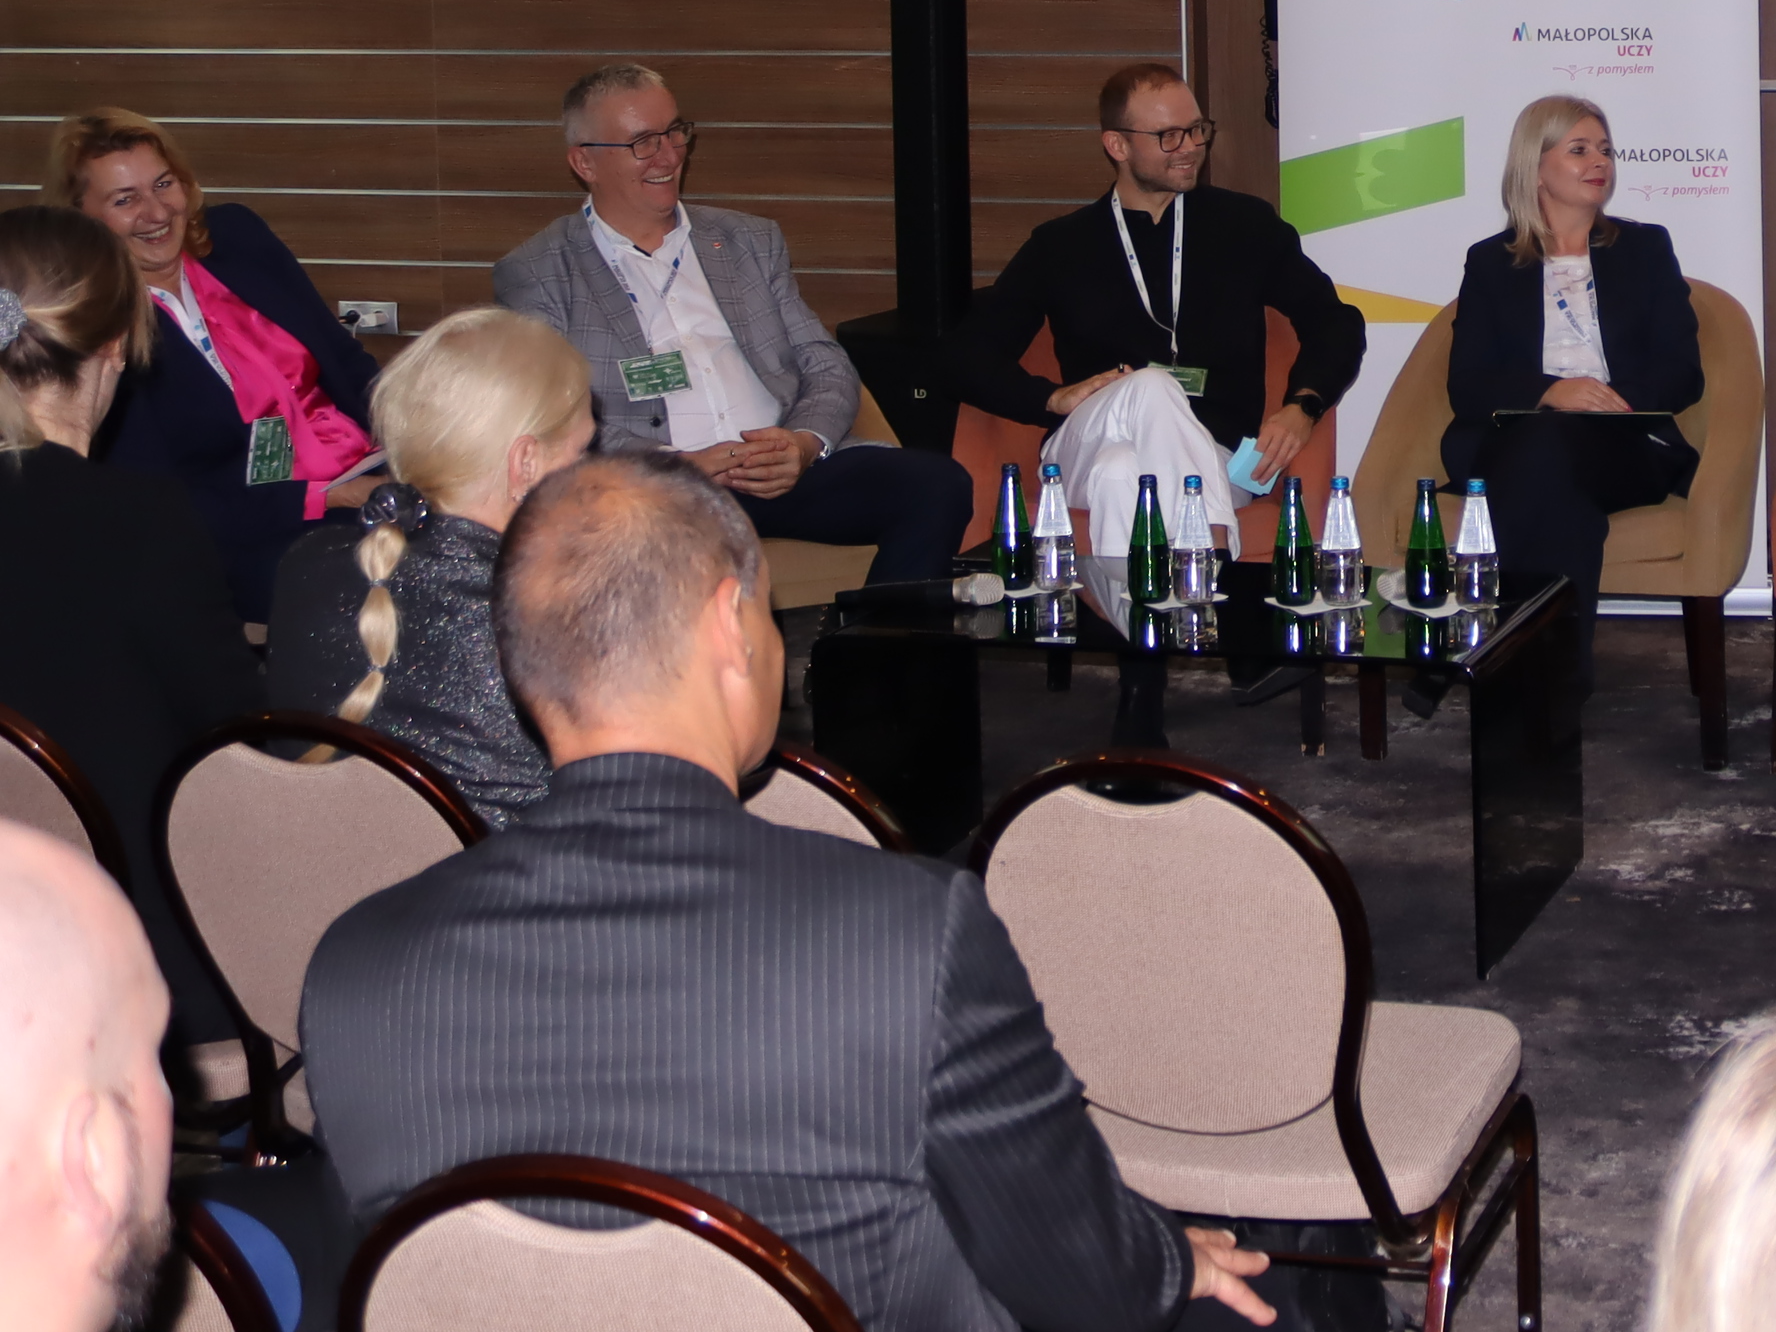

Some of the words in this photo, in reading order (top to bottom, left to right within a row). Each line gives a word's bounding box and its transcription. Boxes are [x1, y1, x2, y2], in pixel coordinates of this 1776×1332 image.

[1537, 27, 1653, 42] MAŁOPOLSKA
[1617, 45, 1653, 57] UCZY
[1596, 63, 1654, 77] pomysłem
[1613, 148, 1728, 162] MAŁOPOLSKA
[1692, 166, 1728, 178] UCZY
[1671, 184, 1730, 198] pomysłem
